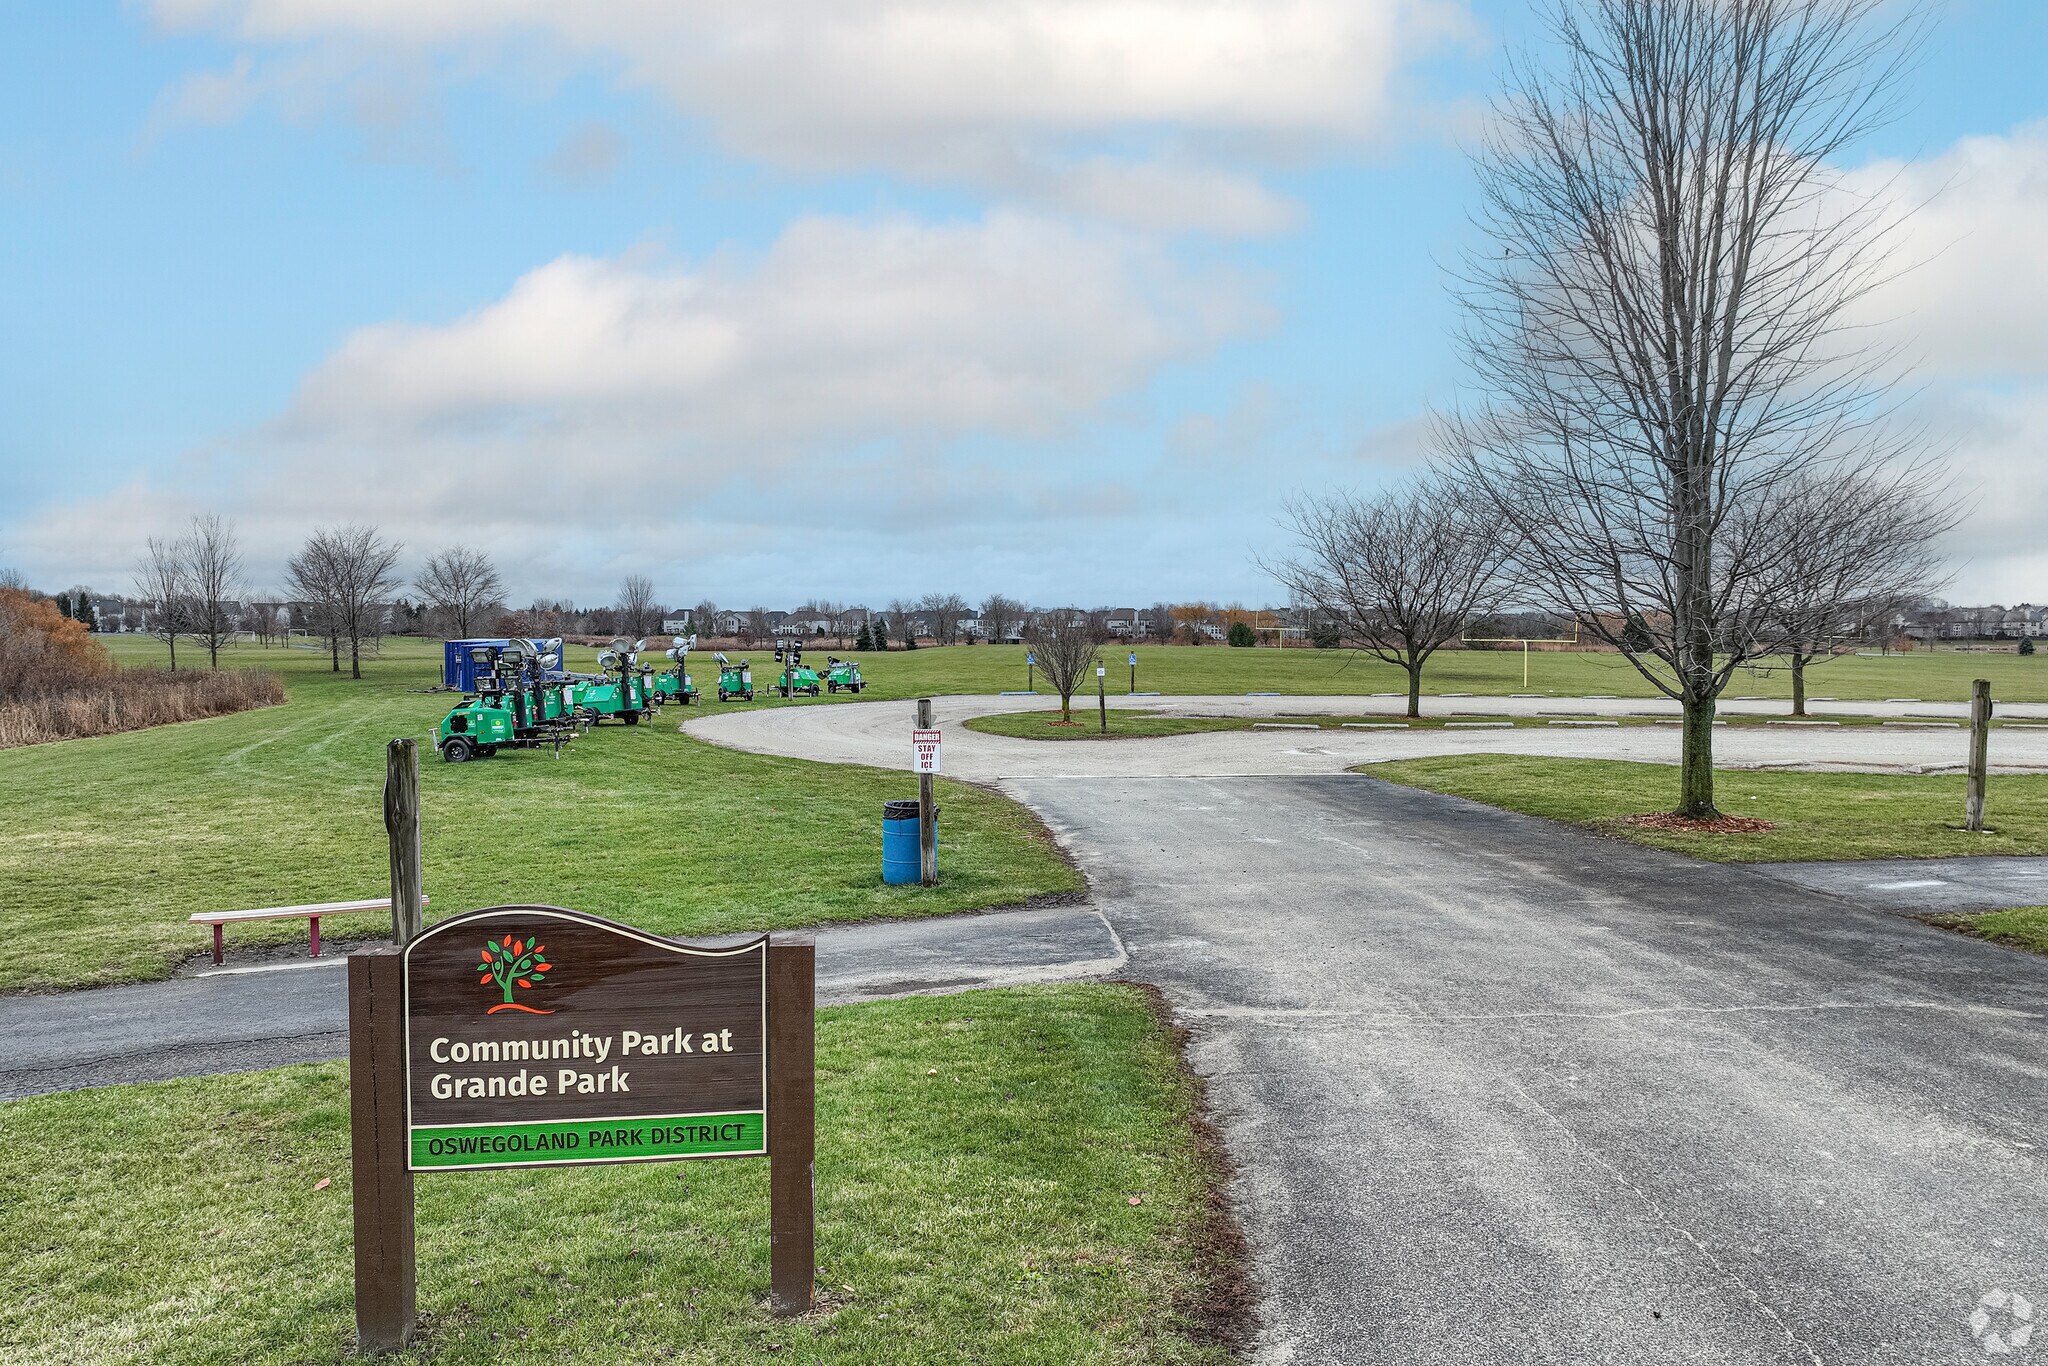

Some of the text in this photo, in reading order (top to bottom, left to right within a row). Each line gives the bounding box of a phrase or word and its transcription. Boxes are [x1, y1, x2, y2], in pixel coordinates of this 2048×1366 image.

[918, 744, 936, 752] STAY
[921, 761, 933, 769] ICE
[430, 1027, 733, 1064] Community Park at
[430, 1066, 630, 1099] Grande Park
[428, 1123, 746, 1156] OSWEGOLAND PARK DISTRICT
